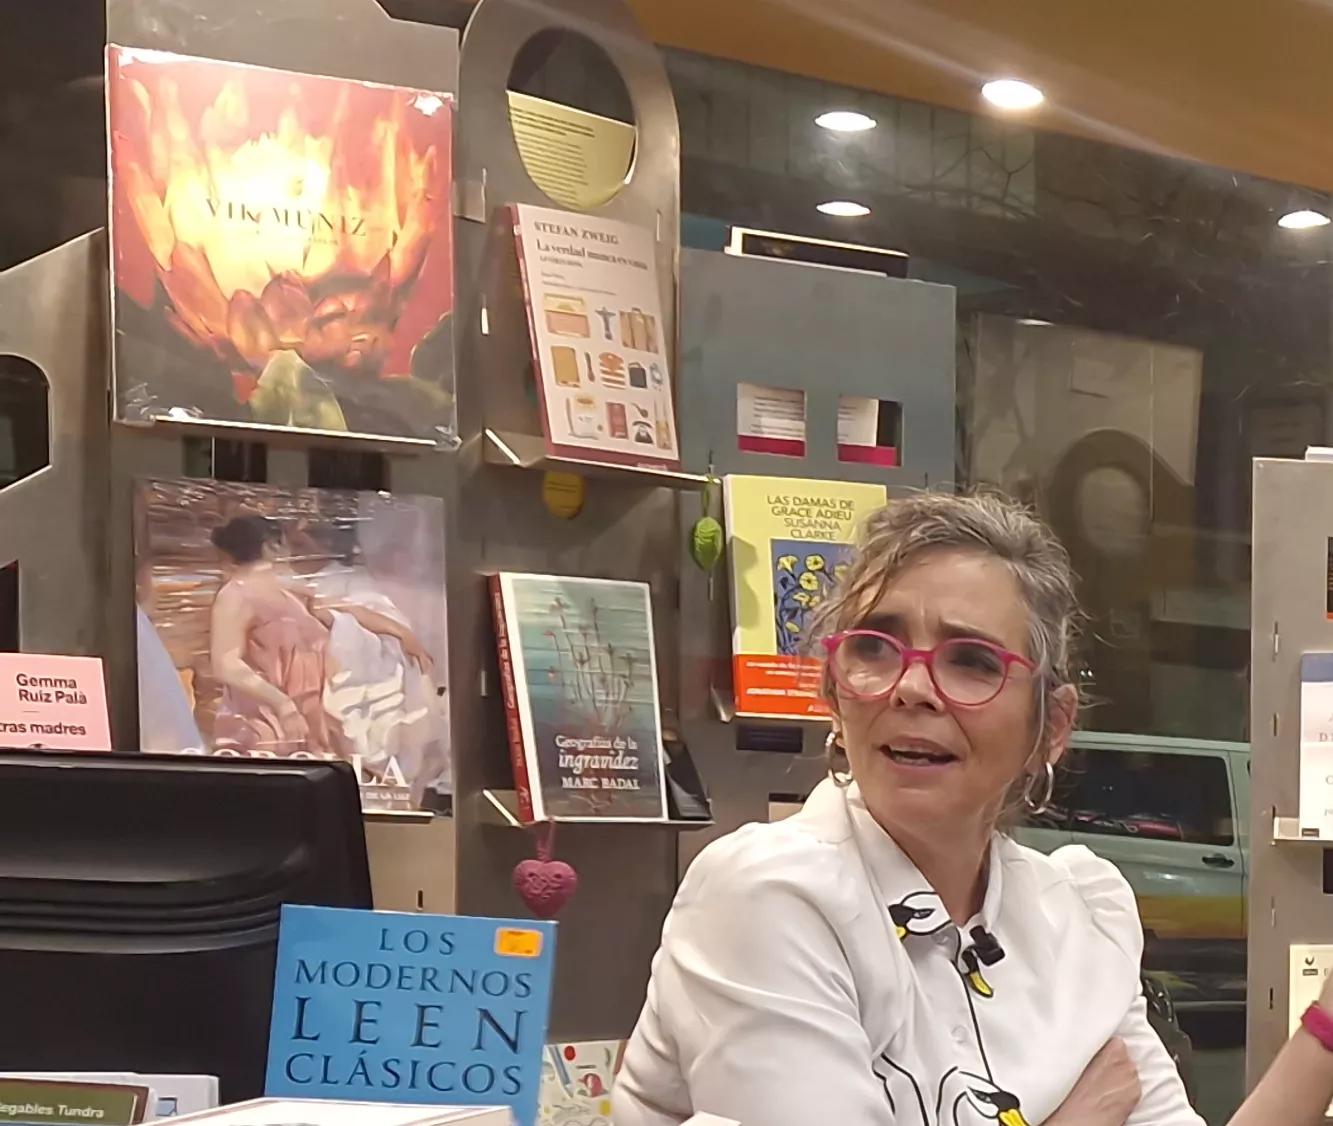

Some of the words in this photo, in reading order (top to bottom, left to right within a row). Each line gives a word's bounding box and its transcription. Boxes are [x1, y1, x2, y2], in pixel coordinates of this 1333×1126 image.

[534, 221, 578, 237] STEFAN
[582, 229, 619, 245] ZWEIG
[767, 495, 791, 506] LAS
[792, 496, 838, 508] DAMAS
[771, 506, 814, 518] GRACE
[783, 518, 843, 531] SUSANNA
[790, 529, 838, 541] CLARKE
[16, 672, 78, 690] Gemma
[18, 689, 52, 704] Ruiz
[55, 690, 87, 705] Palà
[30, 722, 87, 736] madres
[613, 735, 626, 749] de
[559, 749, 638, 774] ingravidez
[562, 776, 599, 789] MARC
[601, 778, 641, 790] BADAL
[379, 928, 456, 957] LOS
[293, 959, 533, 998] MODERNOS
[291, 996, 529, 1056] LEEN
[284, 1052, 525, 1097] CLÁSICOS
[58, 1105, 104, 1118] Tundra
